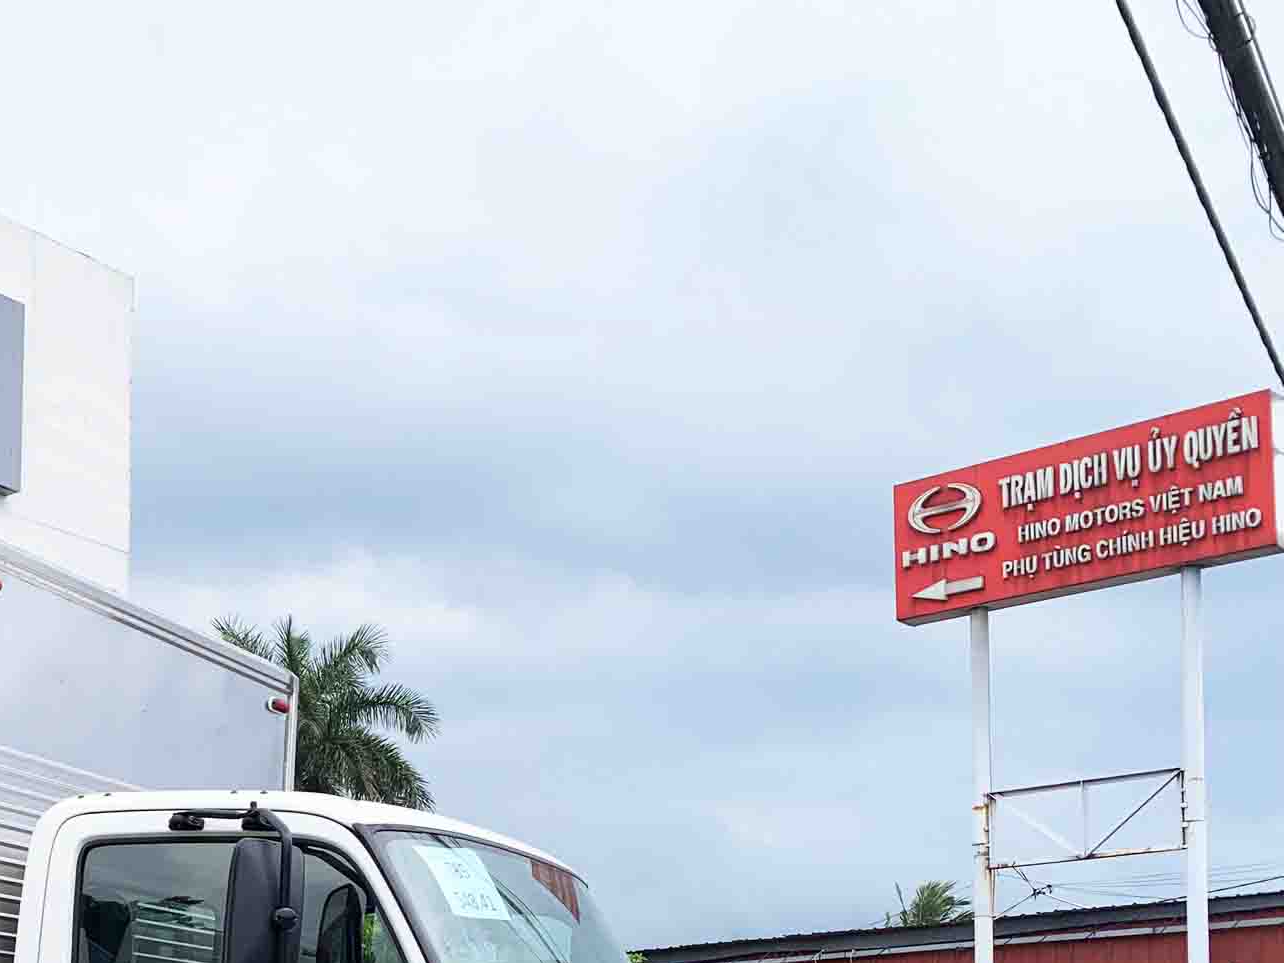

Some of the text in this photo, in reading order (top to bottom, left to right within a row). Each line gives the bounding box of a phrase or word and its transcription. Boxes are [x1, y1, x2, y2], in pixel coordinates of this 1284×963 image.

[998, 407, 1259, 511] TRẠM DỊCH VỤ ỦY QUYỀN
[1002, 508, 1262, 578] PHỤ TÙNG CHÍNH HIỆU HINO
[1018, 475, 1243, 543] HINO MOTORS VIỆT NAM
[902, 531, 996, 568] HINO
